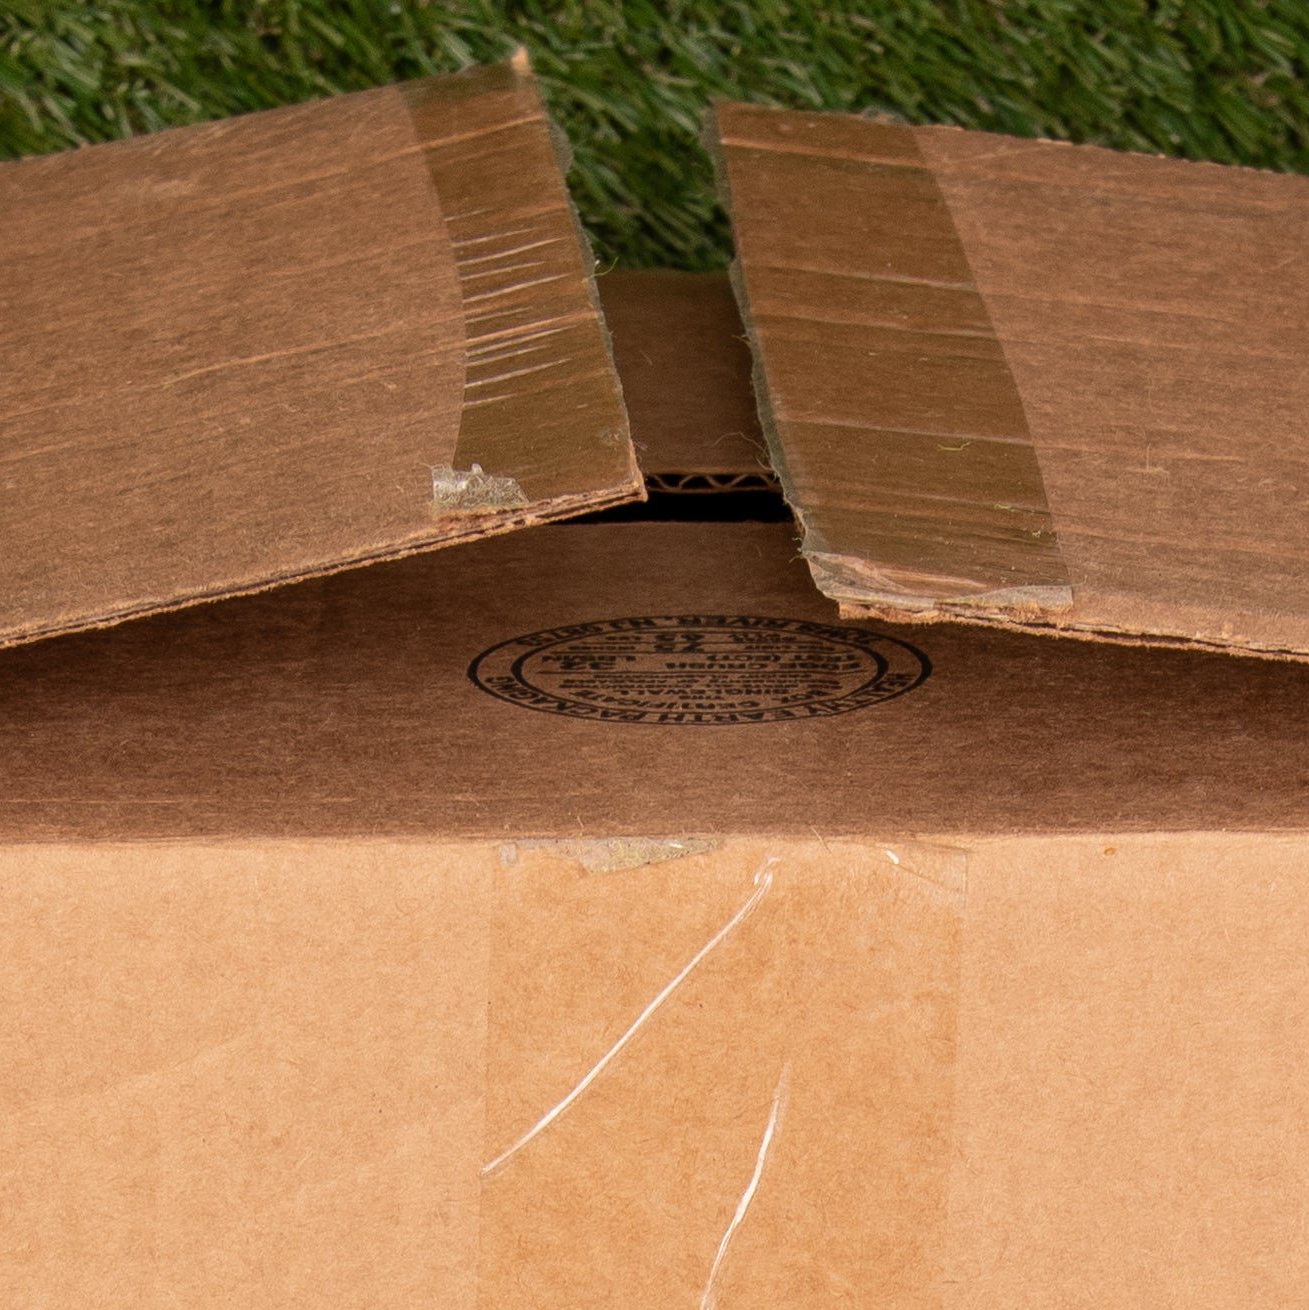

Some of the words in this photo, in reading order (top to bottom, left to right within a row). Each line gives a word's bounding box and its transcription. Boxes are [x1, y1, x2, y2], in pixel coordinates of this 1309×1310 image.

[664, 662, 769, 670] CRUSH
[484, 676, 649, 721] PACKAGING
[567, 690, 761, 710] CERTIFICATE
[656, 710, 798, 722] EARTH
